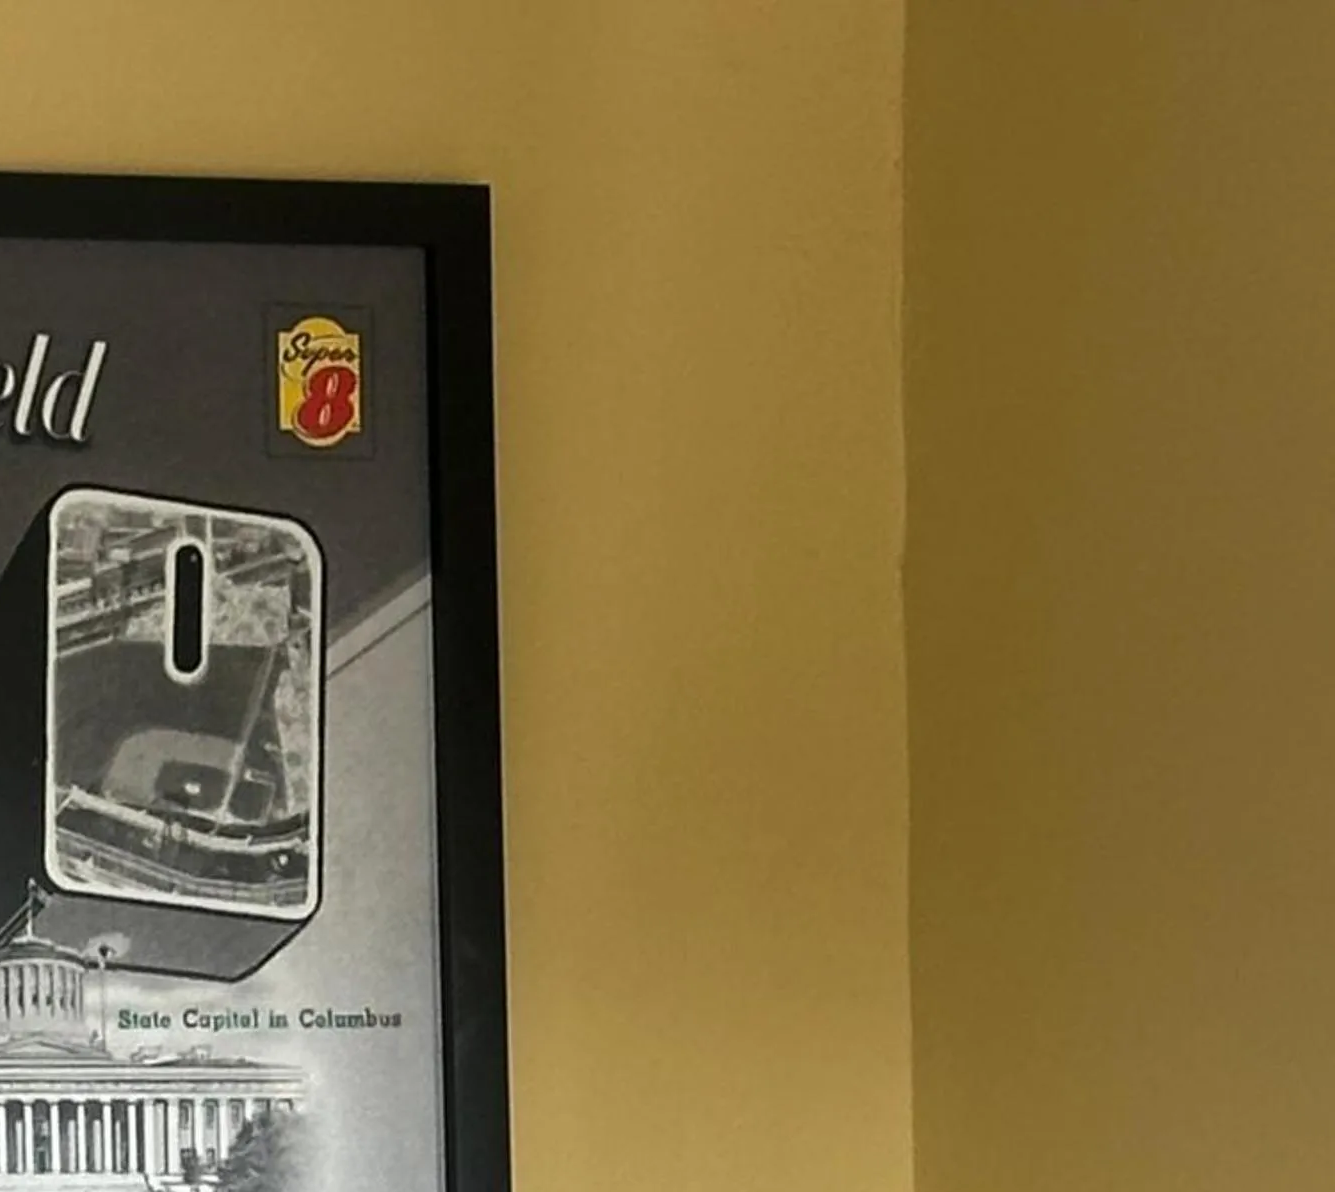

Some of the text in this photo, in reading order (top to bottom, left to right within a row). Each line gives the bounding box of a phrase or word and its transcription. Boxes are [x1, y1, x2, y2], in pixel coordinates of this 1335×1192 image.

[283, 331, 357, 376] Super
[296, 366, 356, 440] 8
[117, 1008, 171, 1029] State
[268, 1008, 288, 1029] in
[299, 1007, 402, 1029] Columbus
